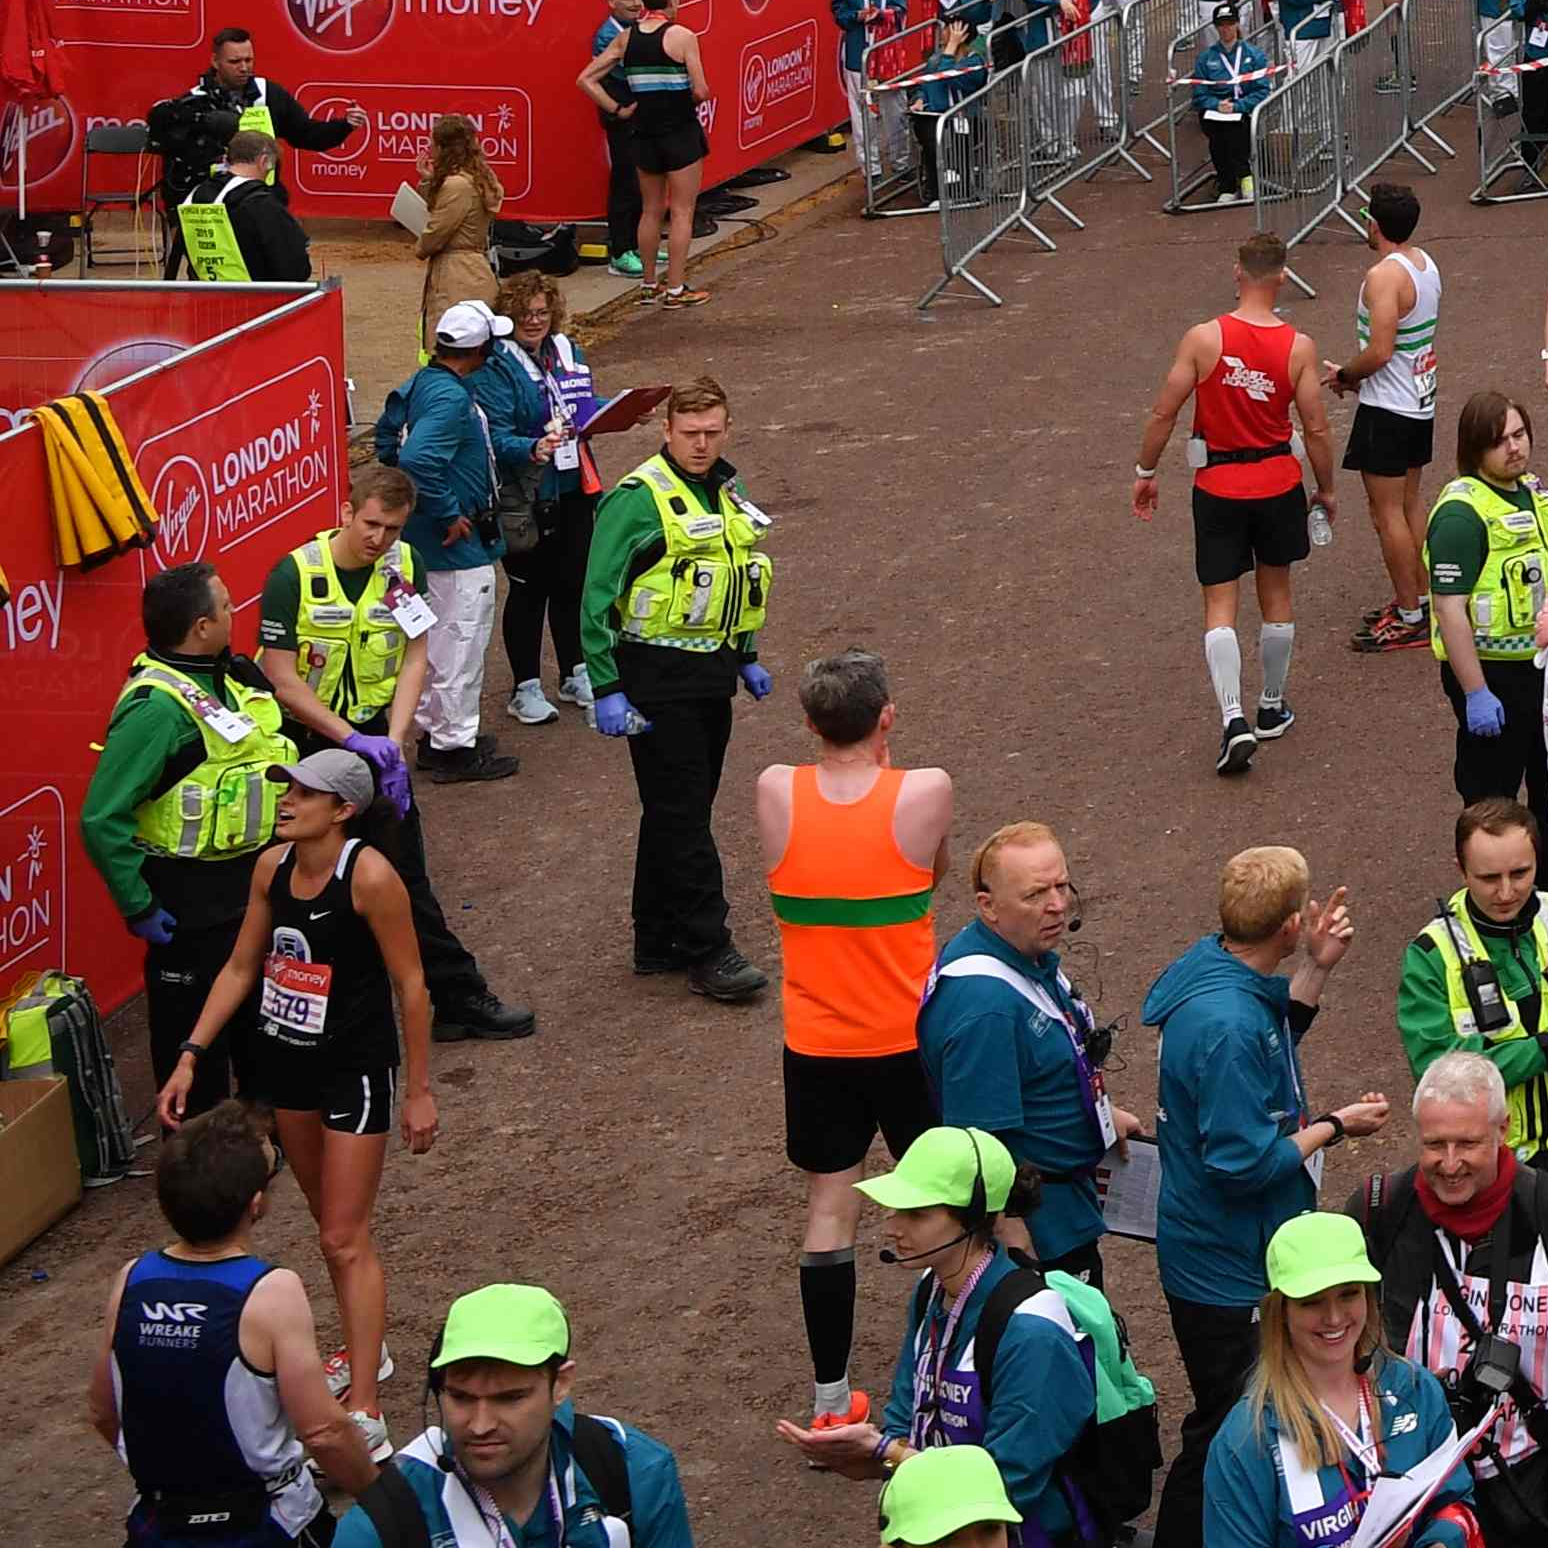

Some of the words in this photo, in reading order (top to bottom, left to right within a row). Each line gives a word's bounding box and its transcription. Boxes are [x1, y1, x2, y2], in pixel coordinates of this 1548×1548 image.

[767, 48, 803, 79] LONDON
[766, 67, 813, 99] MARATHON
[311, 162, 368, 181] money
[212, 421, 300, 495] LONDON
[215, 445, 328, 540] MARATHON
[158, 480, 202, 556] Virgin
[288, 966, 328, 989] money
[139, 1335, 198, 1349] RUNNERS
[140, 1323, 202, 1339] WREAKE
